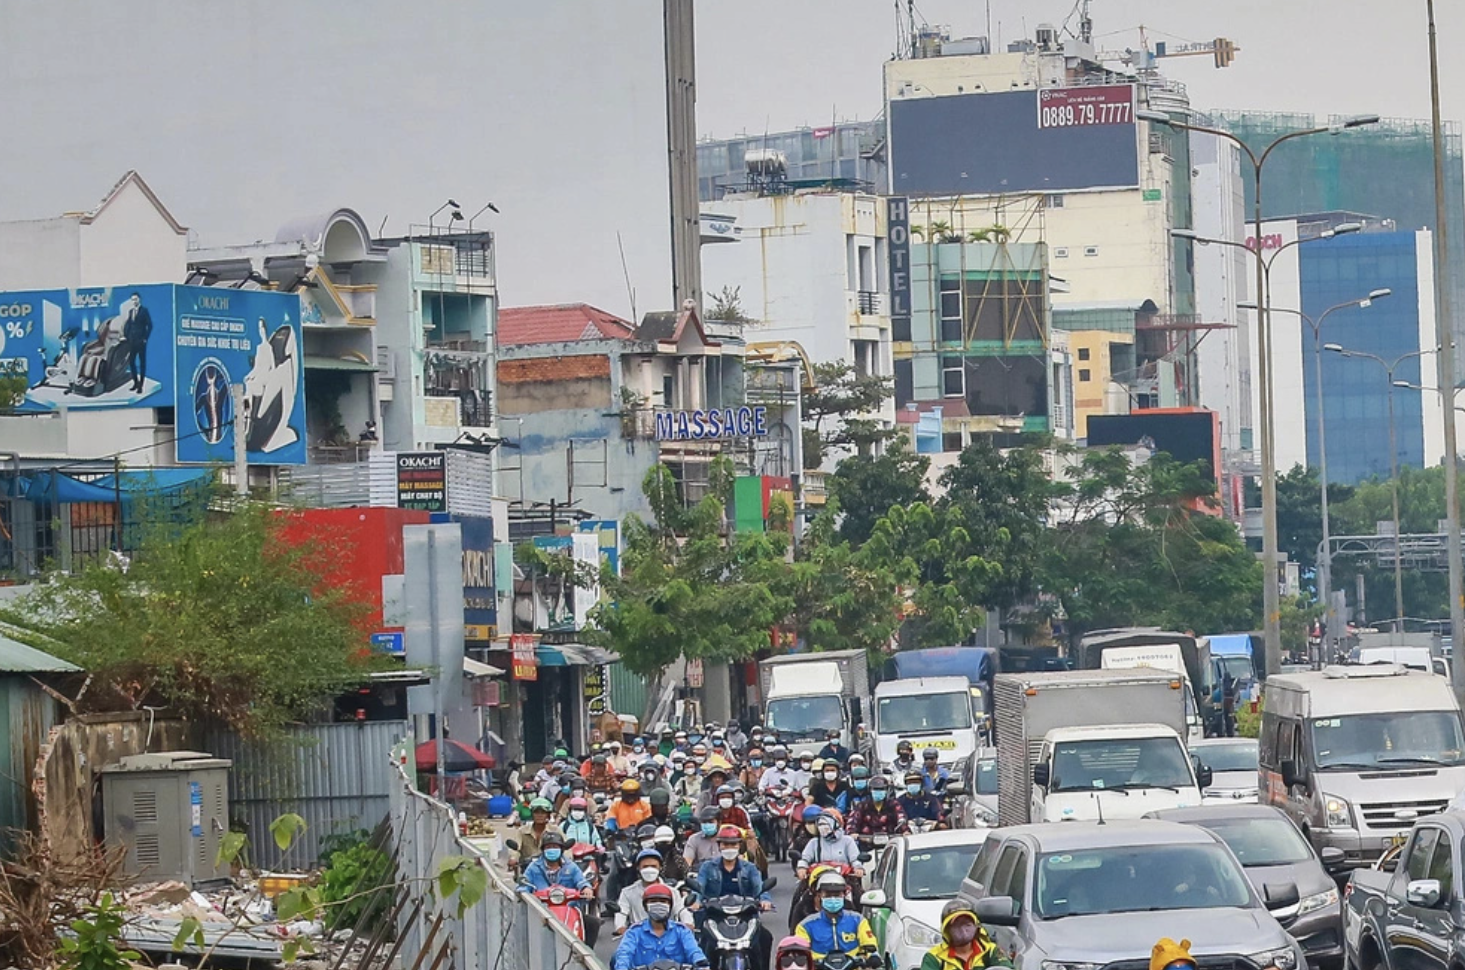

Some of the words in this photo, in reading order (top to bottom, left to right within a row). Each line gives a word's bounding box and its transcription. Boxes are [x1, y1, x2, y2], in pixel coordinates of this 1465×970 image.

[1043, 102, 1130, 127] 0889.79.7777
[890, 202, 906, 314] HOTEL
[656, 406, 767, 440] MASSAGE
[400, 456, 442, 467] OKACHI
